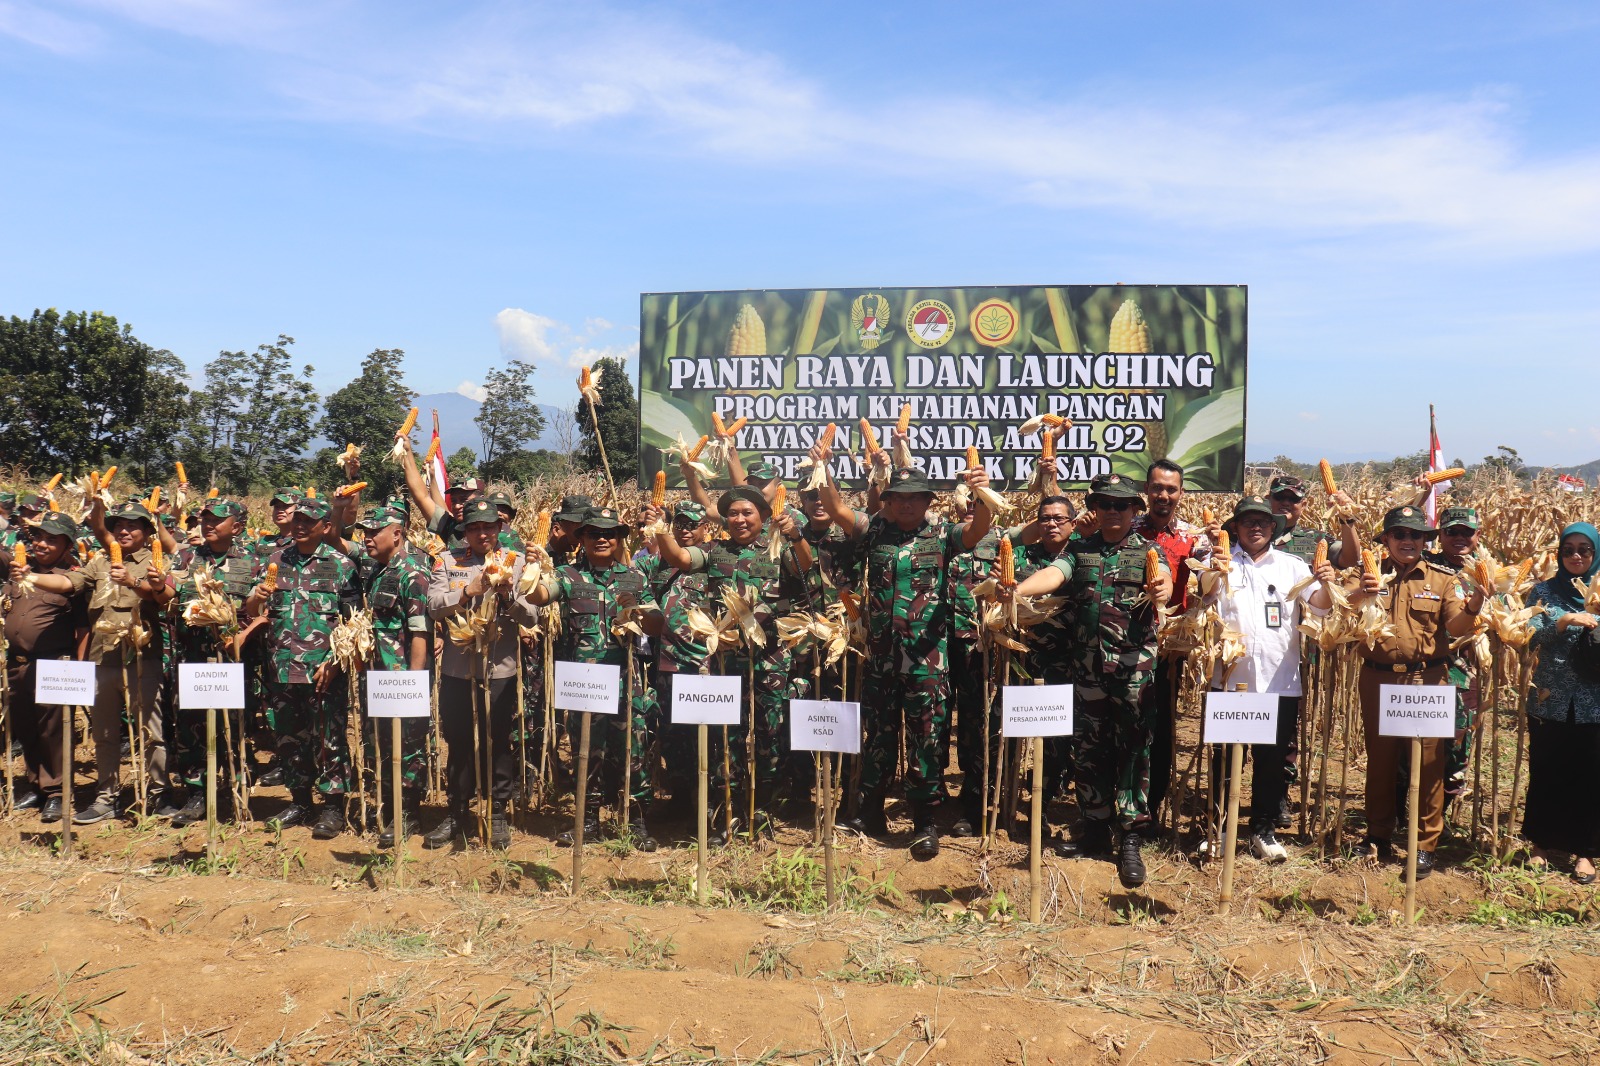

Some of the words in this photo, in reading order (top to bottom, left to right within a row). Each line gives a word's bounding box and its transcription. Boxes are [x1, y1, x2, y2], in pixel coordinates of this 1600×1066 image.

[669, 357, 784, 389] PANEN
[796, 356, 894, 388] RAYA
[906, 355, 985, 387] DAN
[997, 354, 1214, 388] LAUNCHING
[714, 395, 859, 420] PROGRAM
[867, 395, 1038, 419] KETAHANAN
[1047, 394, 1165, 419] PANGAN
[1104, 425, 1144, 451] 92
[912, 456, 1005, 480] BAPK
[1014, 456, 1110, 481] KSAD
[194, 671, 228, 679] DANDIM
[378, 678, 417, 687] KAPOLRES
[563, 680, 586, 689] KAPOK
[588, 682, 607, 690] SAHLI
[193, 684, 212, 692] 0617
[214, 684, 230, 692] MJL
[372, 692, 424, 700] MAJALENGKA
[560, 691, 589, 699] PANGDAM
[678, 692, 734, 704] PANGDAM
[1390, 694, 1402, 705] PJ
[1404, 694, 1446, 705] BUPATI
[1011, 705, 1034, 713] KETUA
[1035, 704, 1065, 712] YAYASAN
[1009, 715, 1038, 723] PERSADA
[1039, 715, 1058, 723] AKMIL
[1059, 714, 1068, 722] 92
[1212, 711, 1271, 721] KEMENTAN
[1386, 709, 1449, 719] MAJALENGKA
[807, 715, 839, 724] ASINTEL
[812, 727, 834, 736] KSAD
